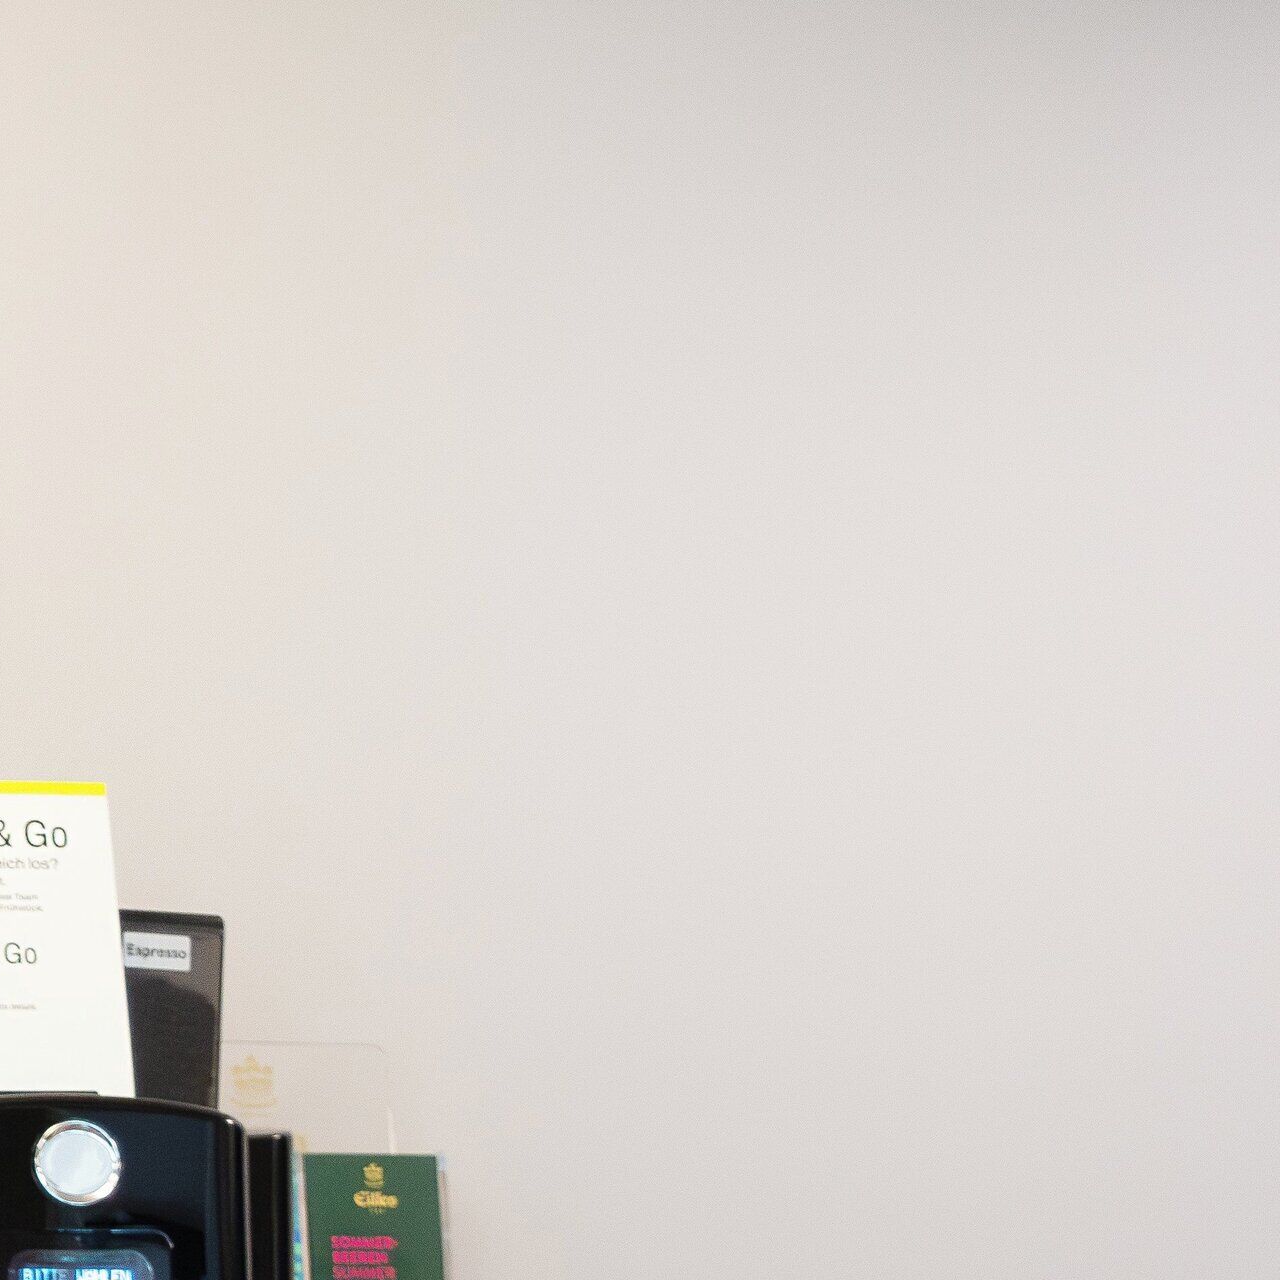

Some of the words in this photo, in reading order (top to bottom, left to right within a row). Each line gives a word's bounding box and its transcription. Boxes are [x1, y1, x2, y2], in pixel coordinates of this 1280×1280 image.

[24, 819, 69, 849] Go
[28, 858, 59, 870] los?
[4, 942, 38, 965] Go
